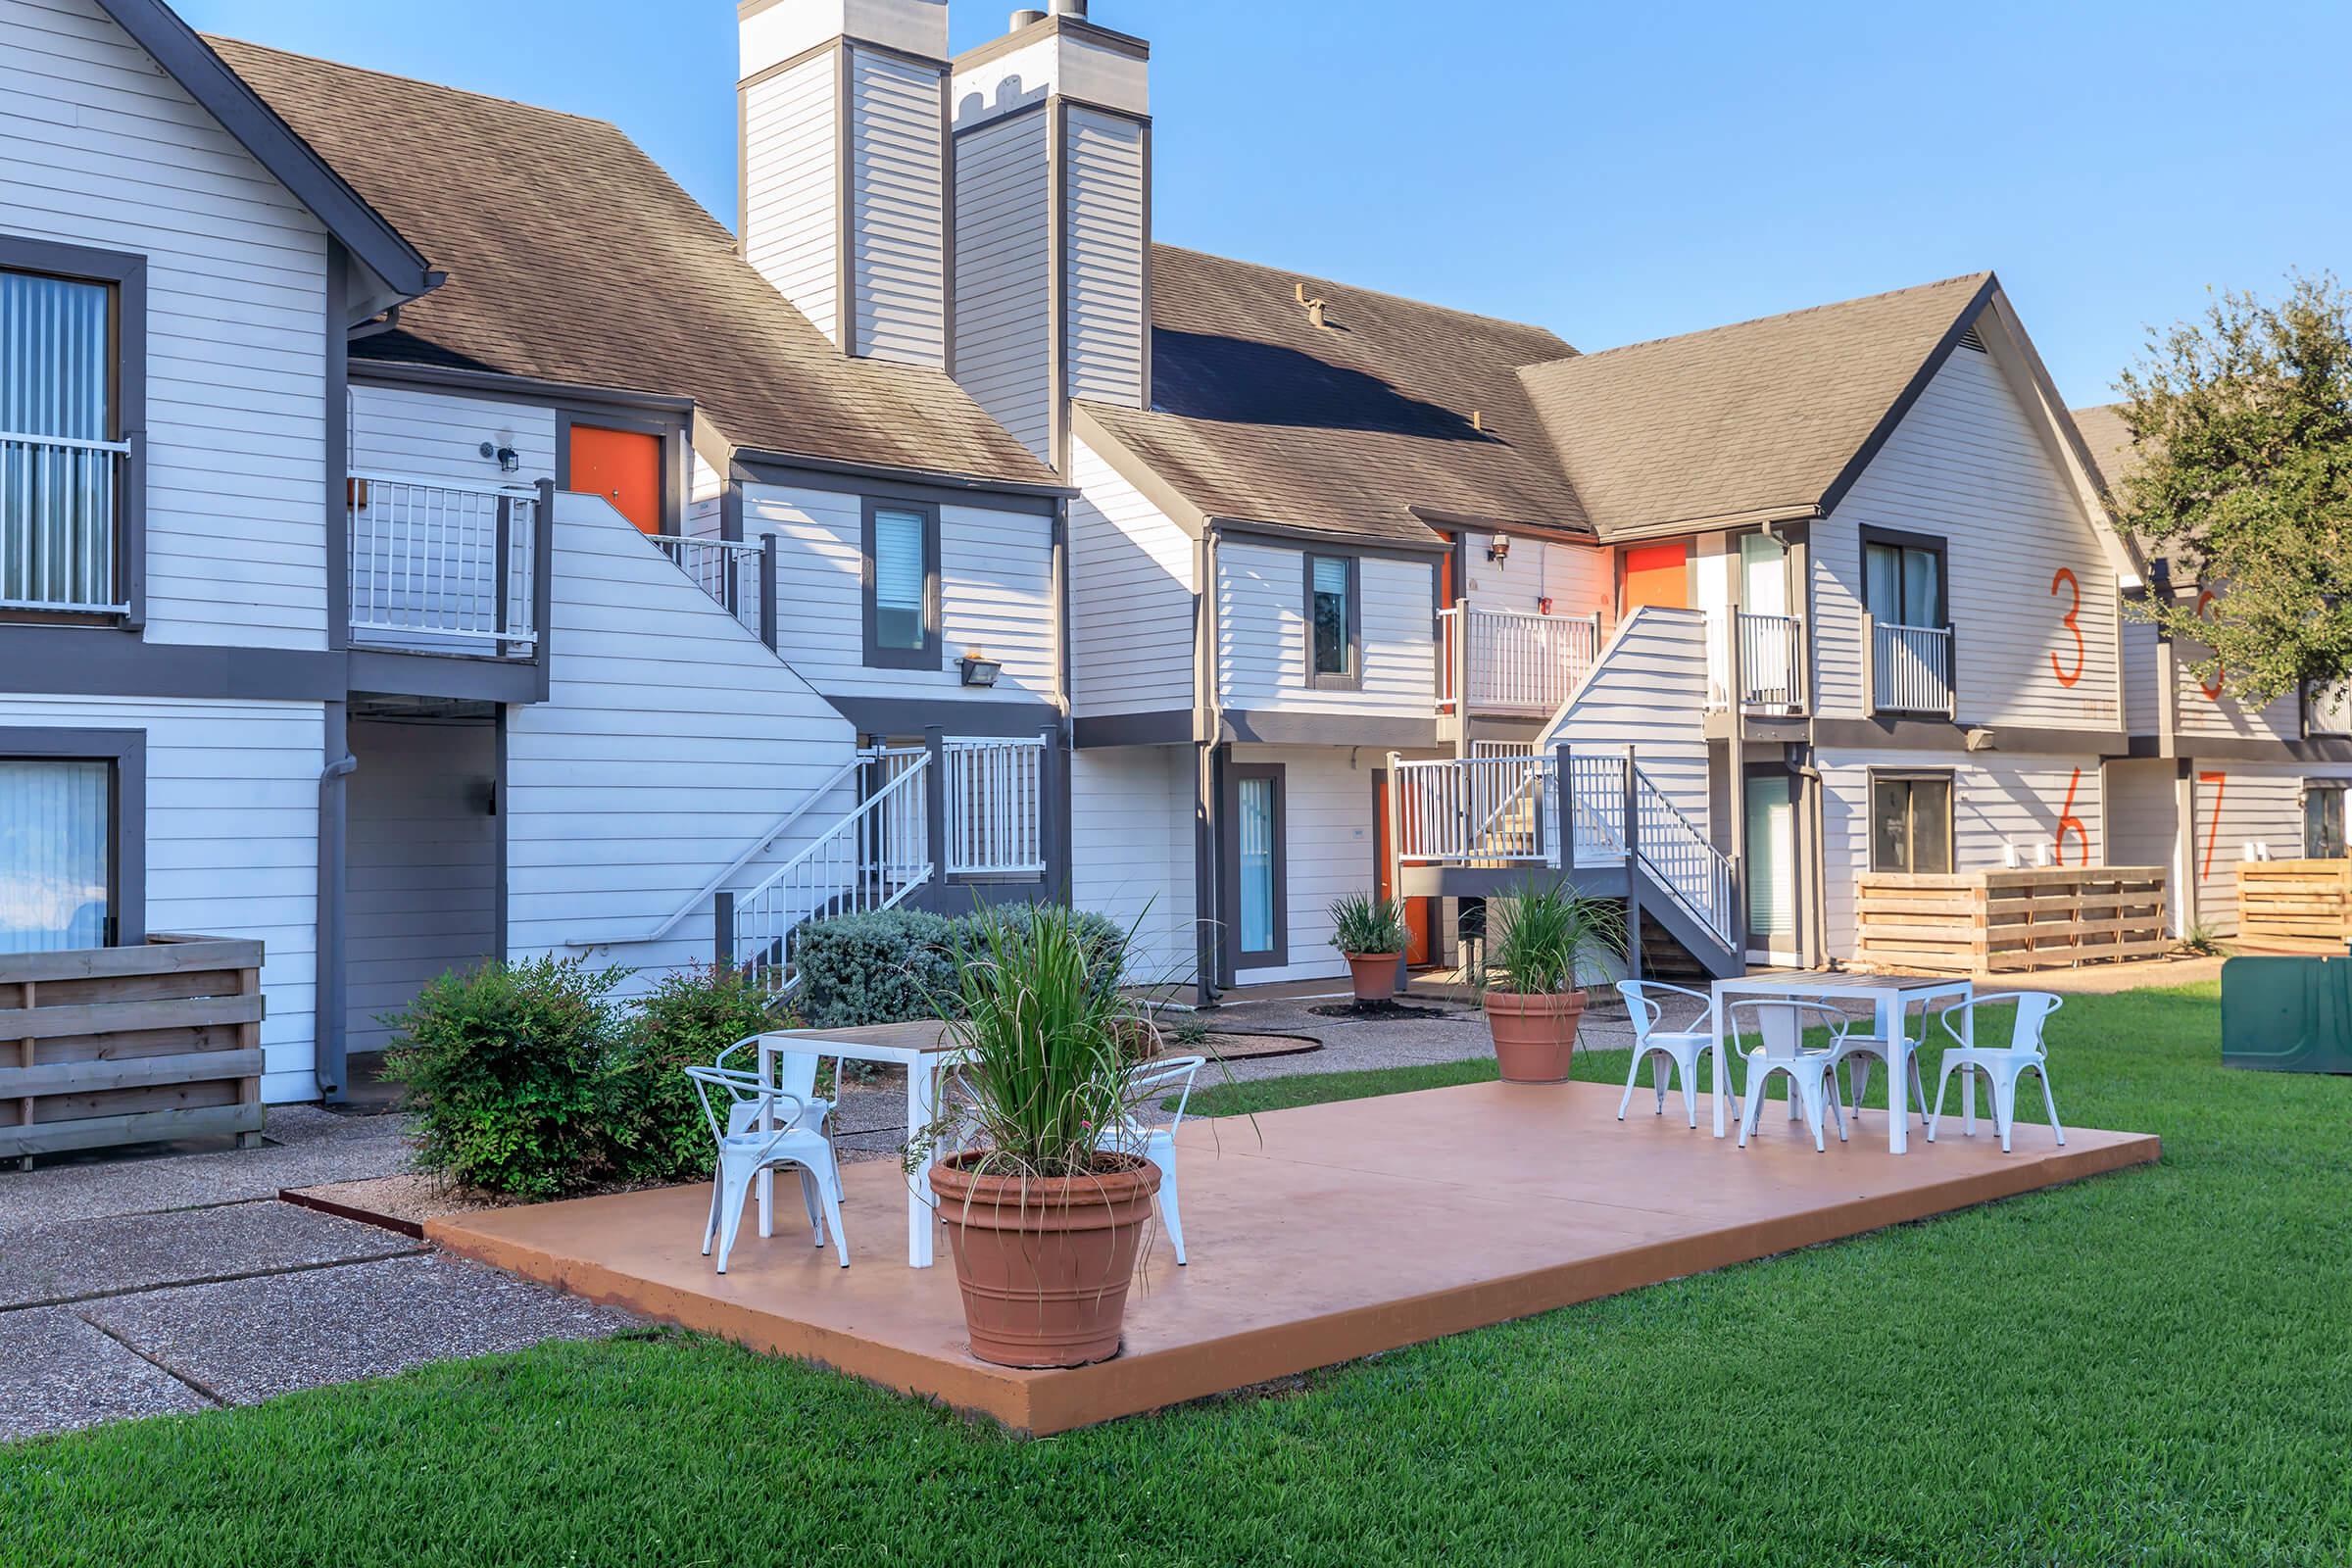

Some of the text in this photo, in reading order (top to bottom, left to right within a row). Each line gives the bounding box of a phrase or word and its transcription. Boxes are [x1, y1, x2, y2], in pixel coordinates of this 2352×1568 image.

[2051, 567, 2084, 688] 3
[2055, 767, 2089, 867] 6
[2198, 770, 2227, 881] 7
